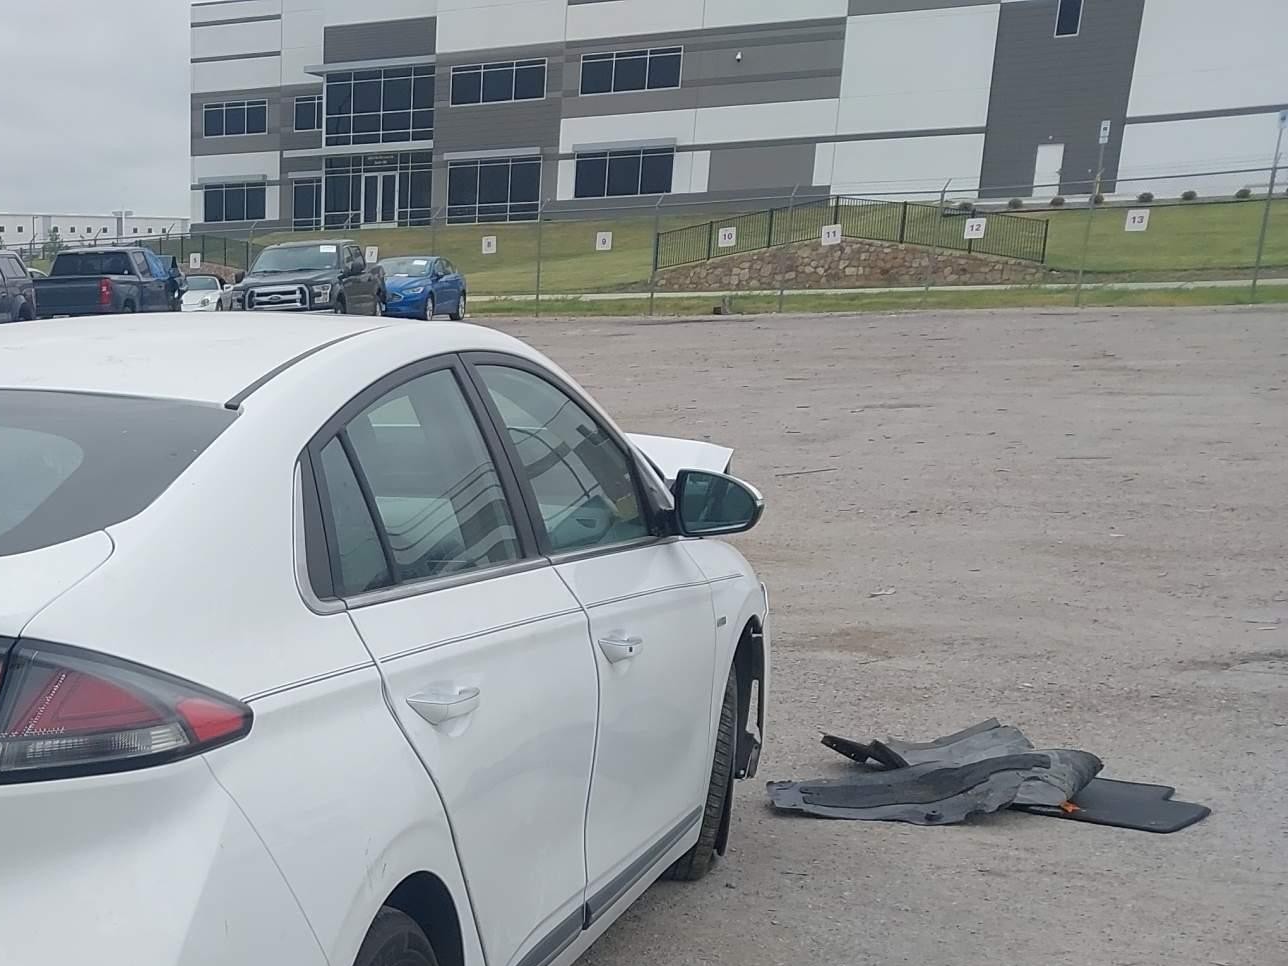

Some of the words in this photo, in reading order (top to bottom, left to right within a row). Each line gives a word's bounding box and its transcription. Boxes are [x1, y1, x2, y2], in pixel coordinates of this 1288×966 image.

[1130, 215, 1145, 225] 13
[969, 223, 982, 232] 12
[722, 232, 734, 241] 10
[825, 230, 837, 239] 11
